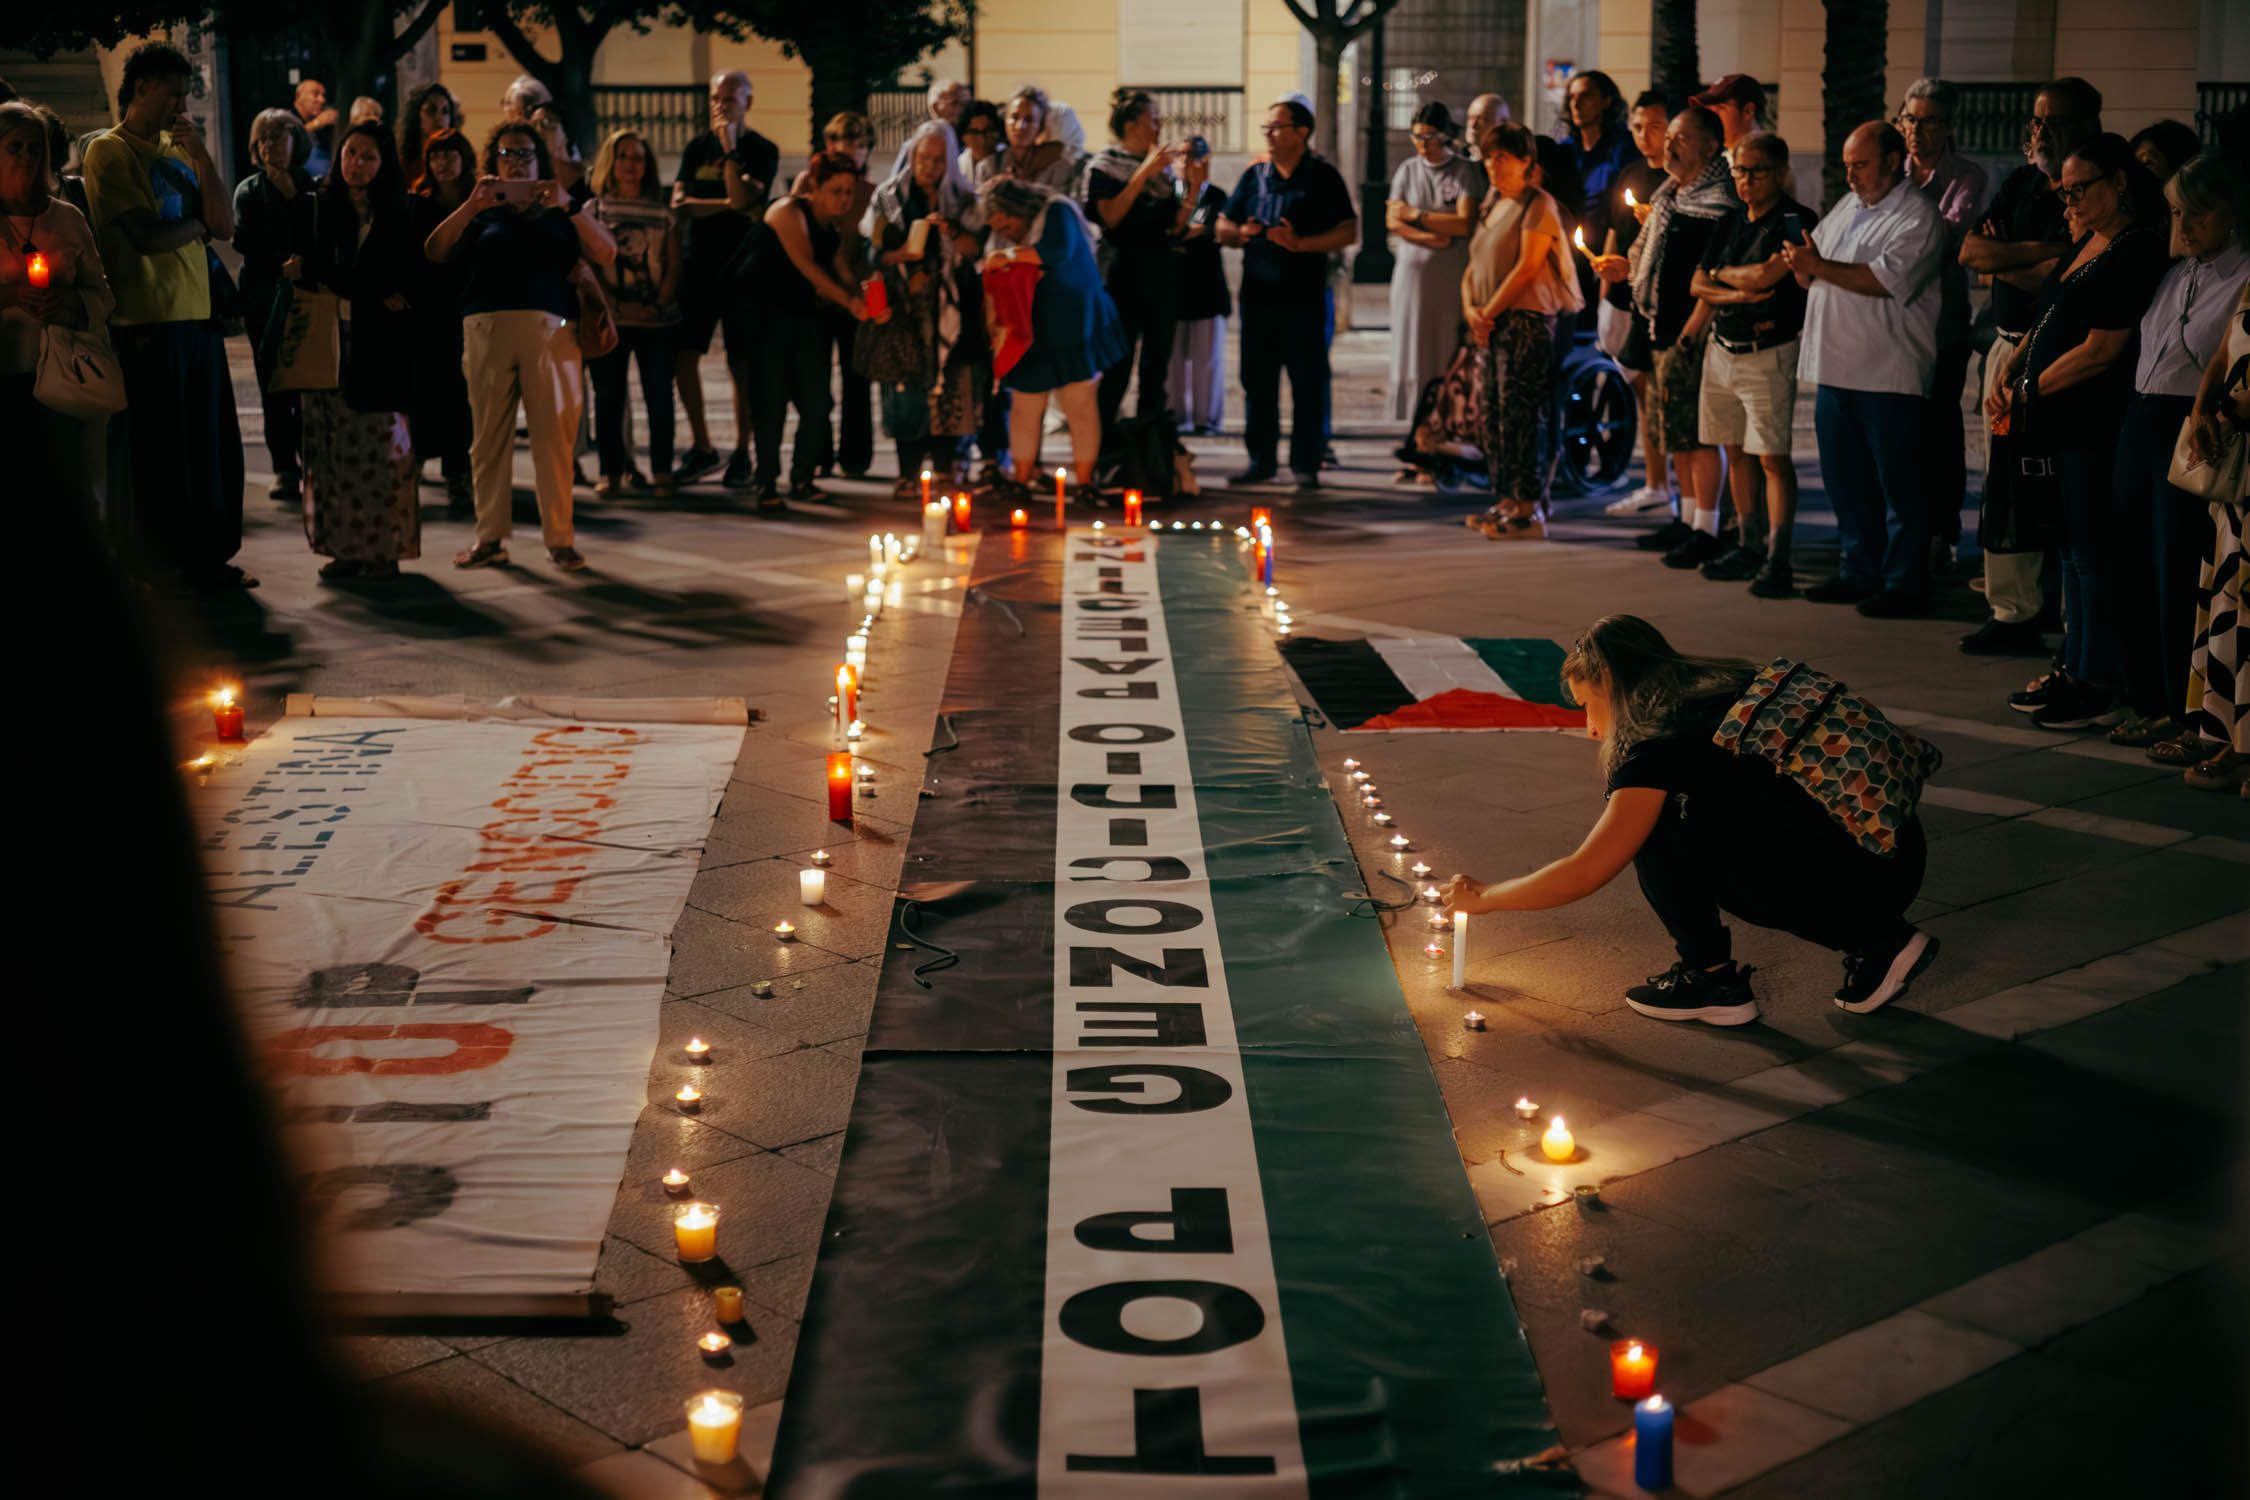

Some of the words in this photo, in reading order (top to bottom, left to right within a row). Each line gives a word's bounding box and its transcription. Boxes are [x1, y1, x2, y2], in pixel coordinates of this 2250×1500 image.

[203, 728, 406, 940] ALESTINA
[414, 726, 641, 944] GENOCIDIO
[1064, 723, 1232, 1115] GENOCIDIO
